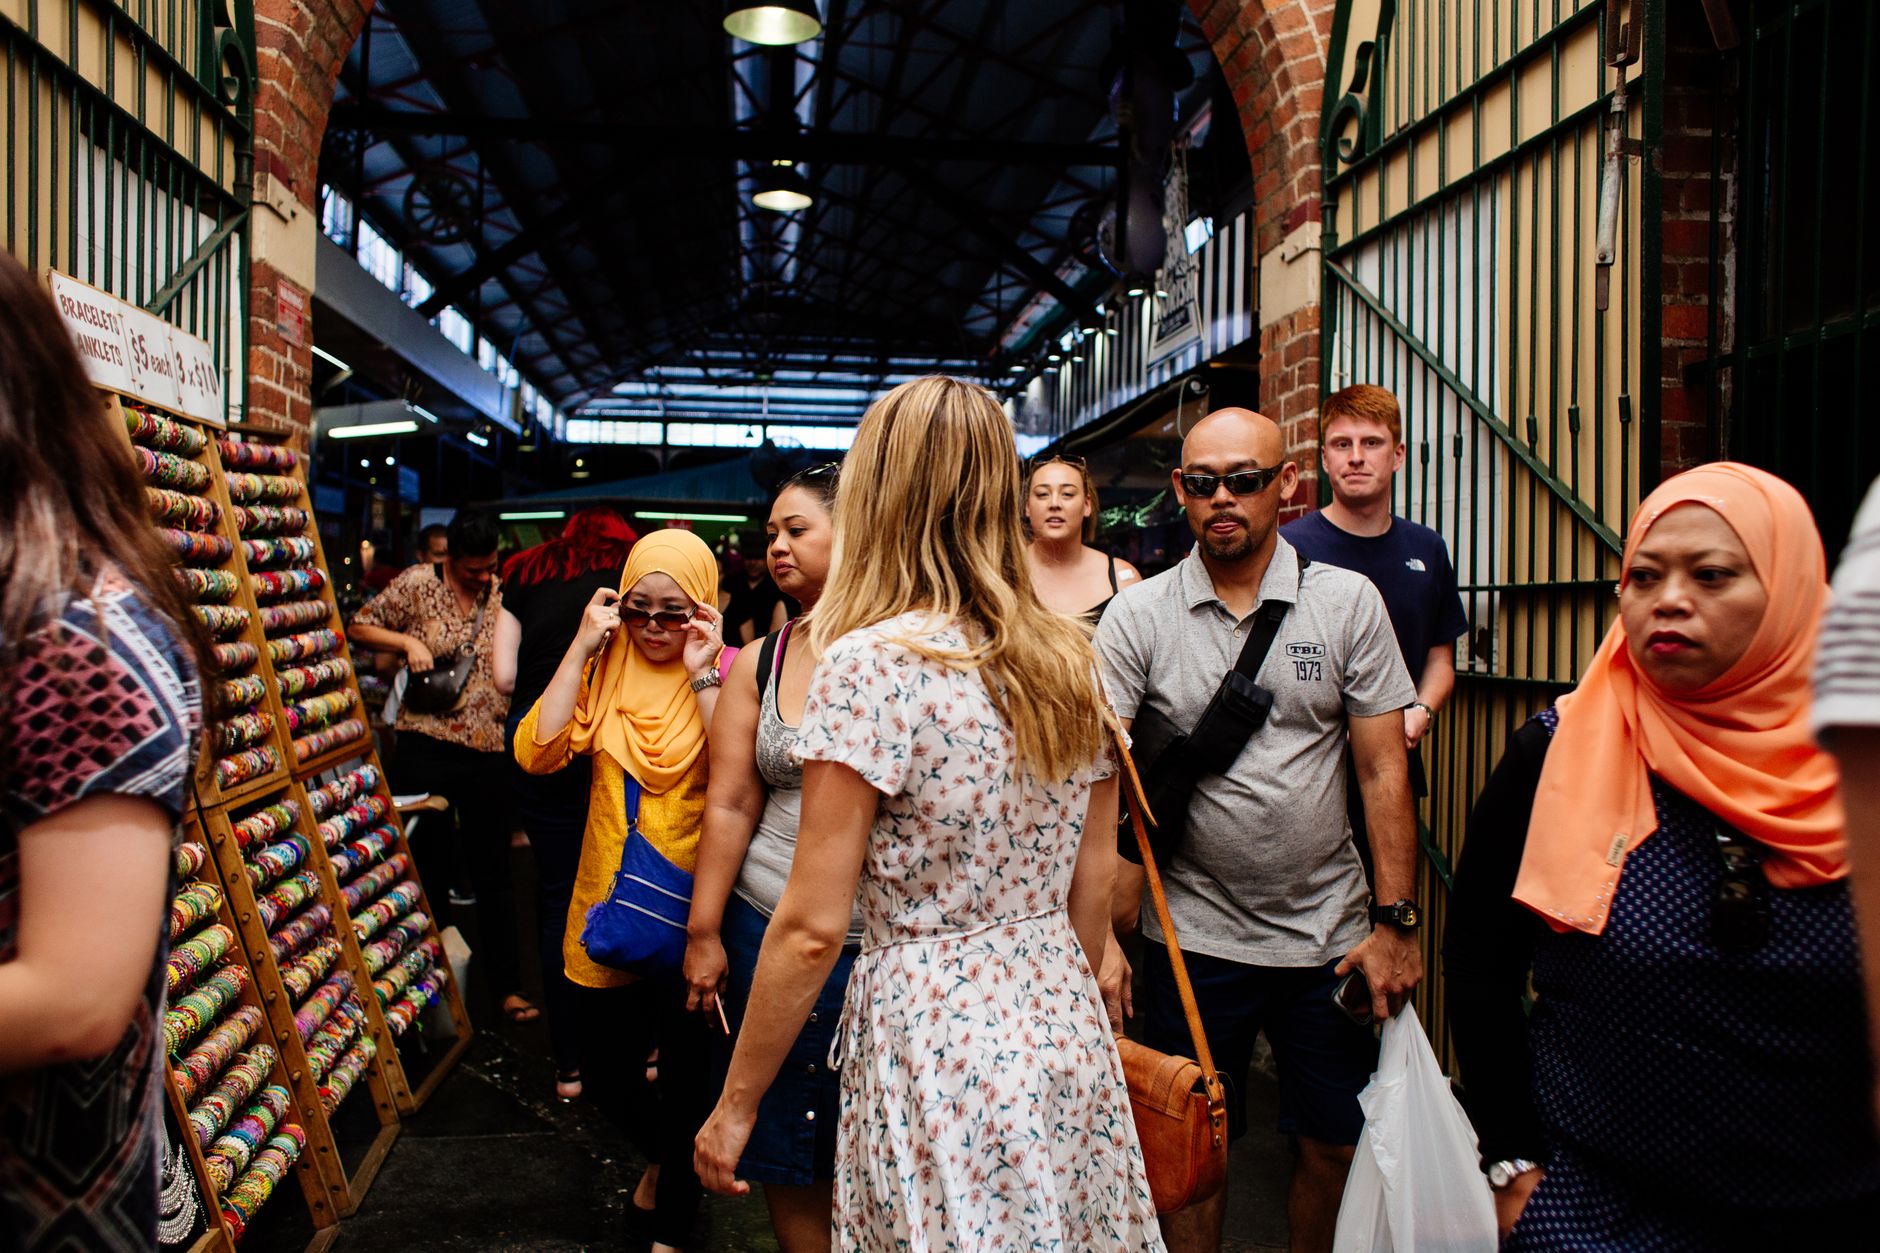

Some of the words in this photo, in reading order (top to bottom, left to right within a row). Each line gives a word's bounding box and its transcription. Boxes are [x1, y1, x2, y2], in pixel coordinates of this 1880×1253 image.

[59, 293, 121, 336] BRACELETS
[76, 332, 124, 367] ANKLETS
[130, 328, 149, 375] $5
[150, 353, 174, 379] each
[175, 351, 186, 385] 3
[1290, 646, 1322, 655] TBL
[1292, 660, 1322, 681] 1973
